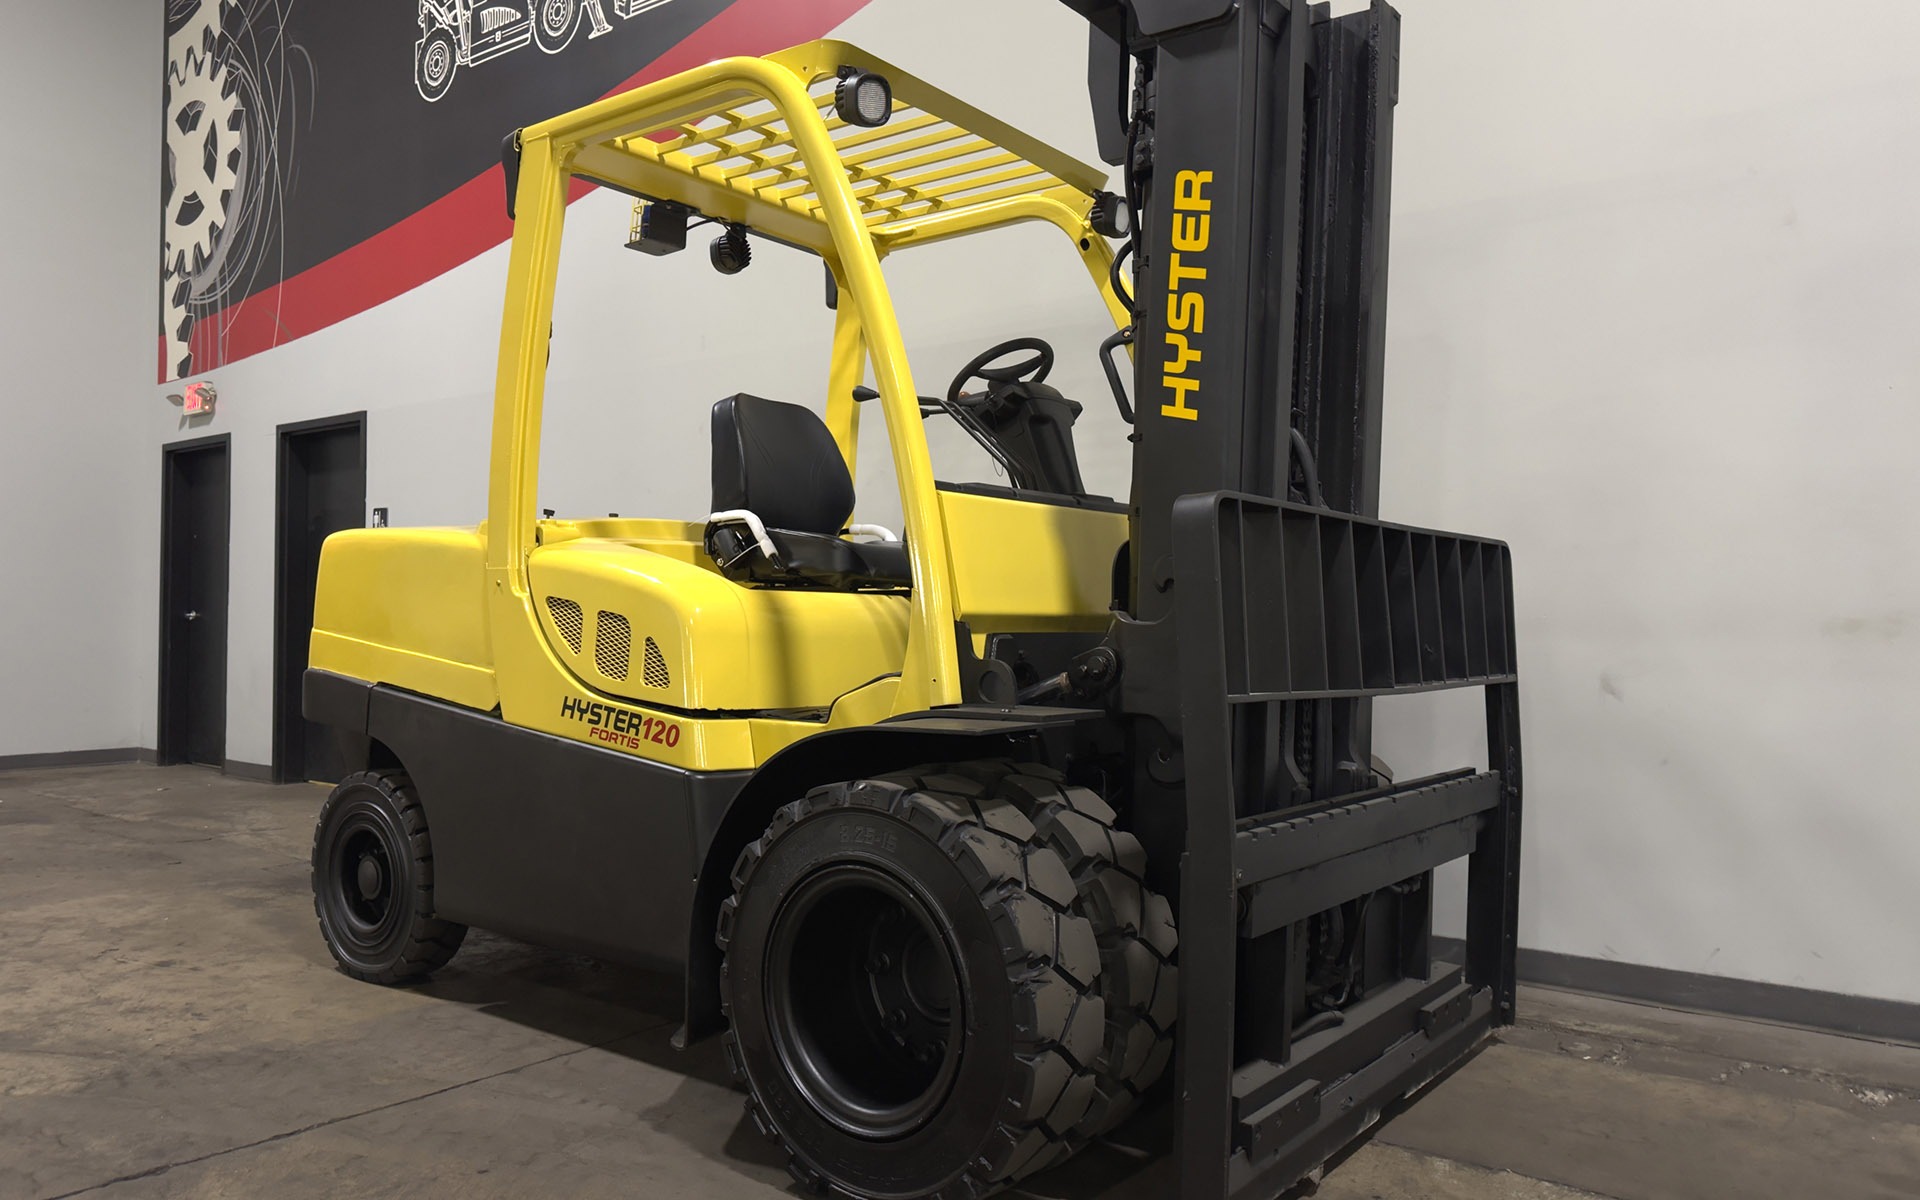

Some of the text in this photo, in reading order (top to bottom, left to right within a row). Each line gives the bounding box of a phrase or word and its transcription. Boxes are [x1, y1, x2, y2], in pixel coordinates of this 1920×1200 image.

[1161, 169, 1213, 421] HYSTER
[561, 696, 680, 748] HYSTER 120
[589, 727, 640, 749] FORTIS
